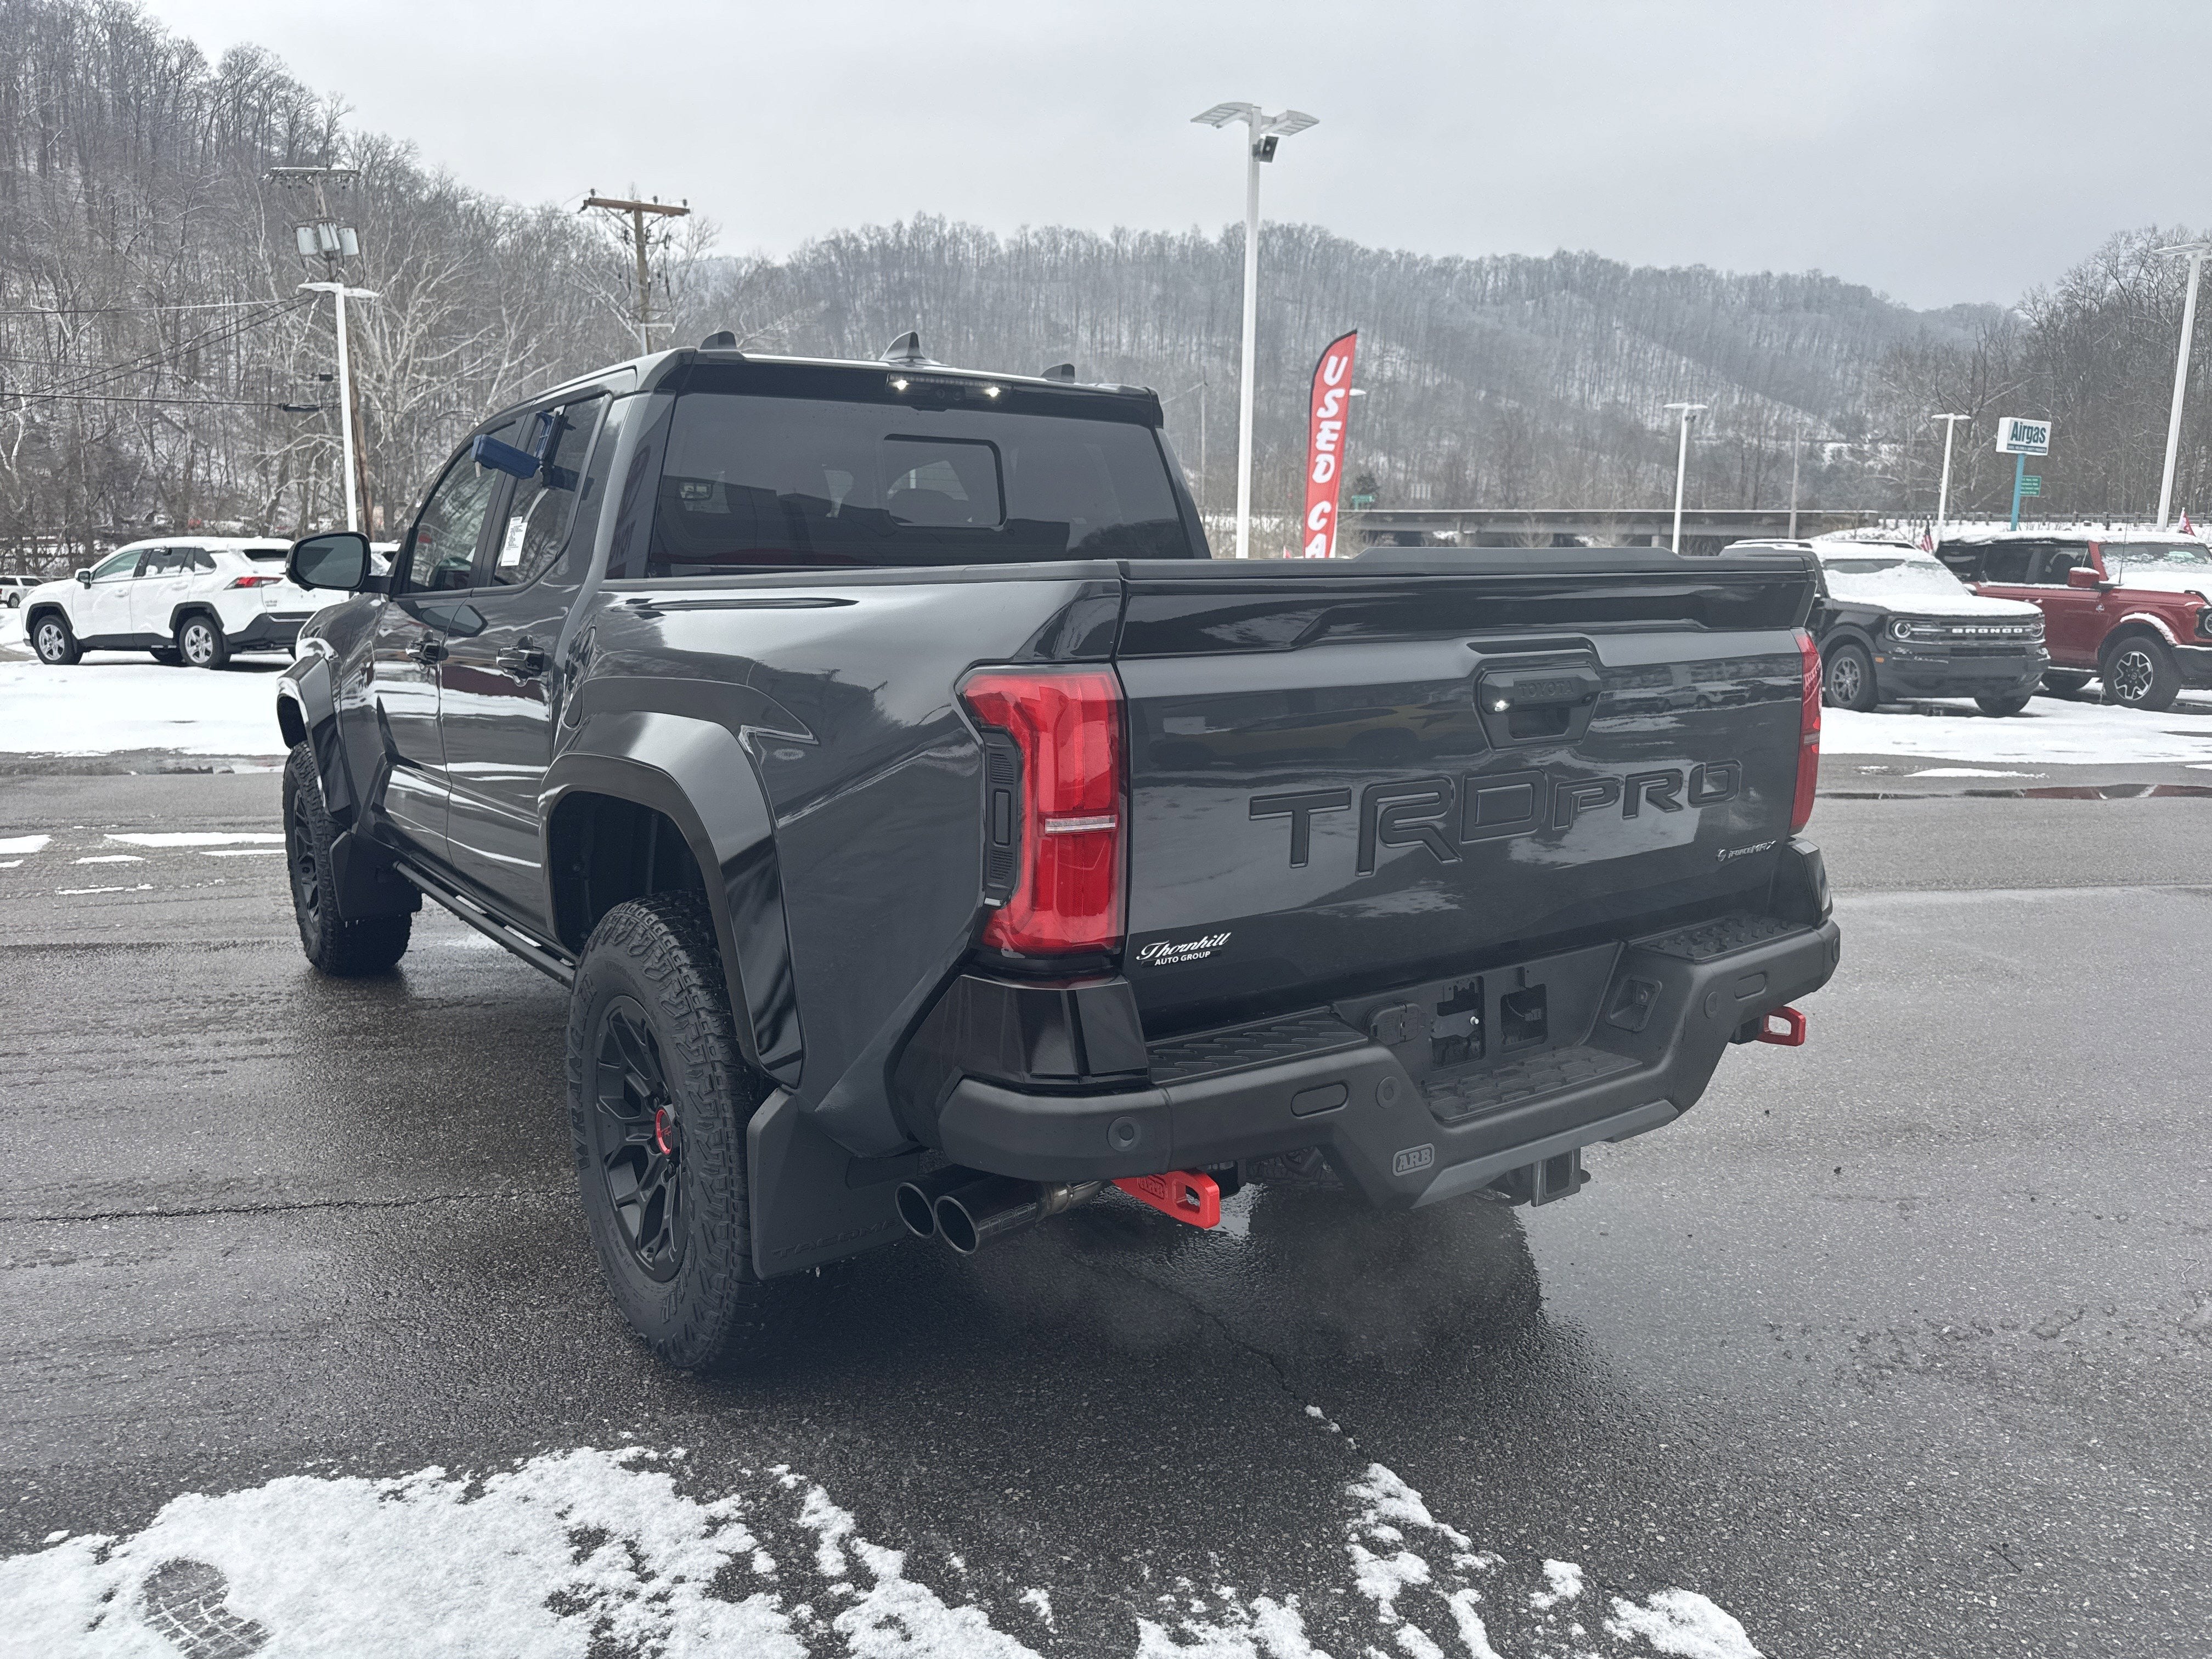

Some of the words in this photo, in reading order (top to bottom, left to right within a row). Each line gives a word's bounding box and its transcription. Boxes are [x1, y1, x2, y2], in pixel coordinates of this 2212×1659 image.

[1312, 355, 1348, 483] USED
[2010, 421, 2046, 444] Airgas
[1518, 681, 1575, 698] TOYOTA
[1136, 932, 1232, 960] Thornhill
[1154, 955, 1179, 966] AUTO
[1180, 951, 1211, 962] GROUP
[568, 972, 597, 1171] WRANGLER
[1397, 1148, 1432, 1172] ARB
